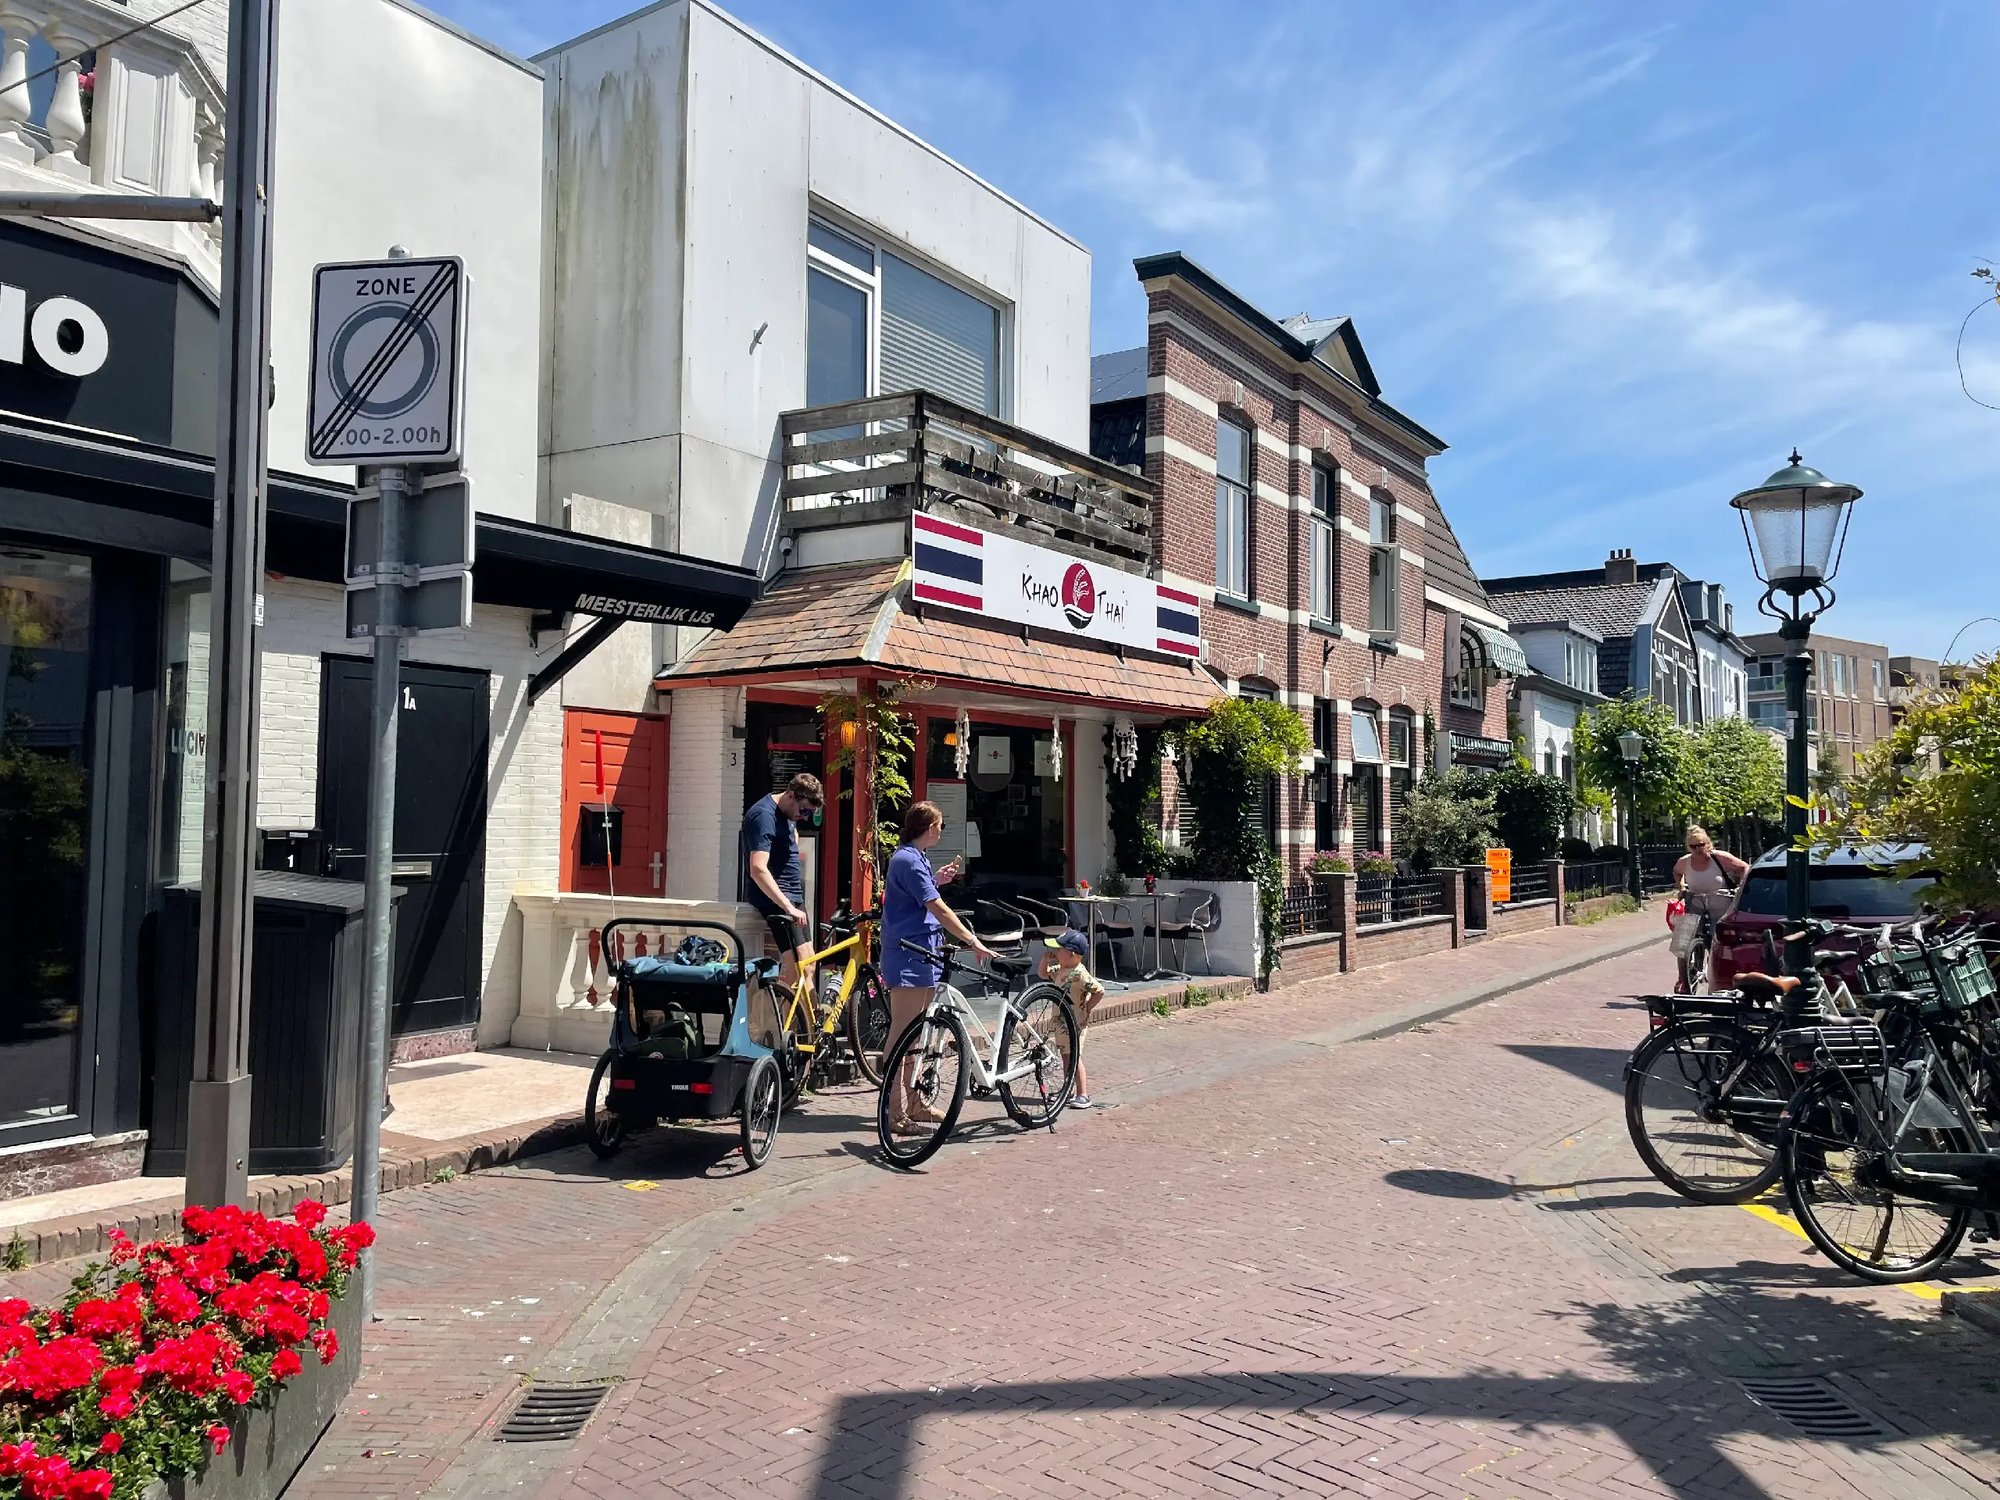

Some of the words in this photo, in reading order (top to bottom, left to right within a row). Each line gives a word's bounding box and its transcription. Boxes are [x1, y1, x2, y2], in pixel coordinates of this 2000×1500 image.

[356, 278, 416, 296] ZONE
[320, 426, 441, 446] .00-2.00h
[575, 594, 689, 621] MEESTERLIJK
[688, 610, 715, 624] IJS
[403, 686, 416, 710] 1A
[730, 752, 737, 766] 3
[287, 854, 294, 868] 1
